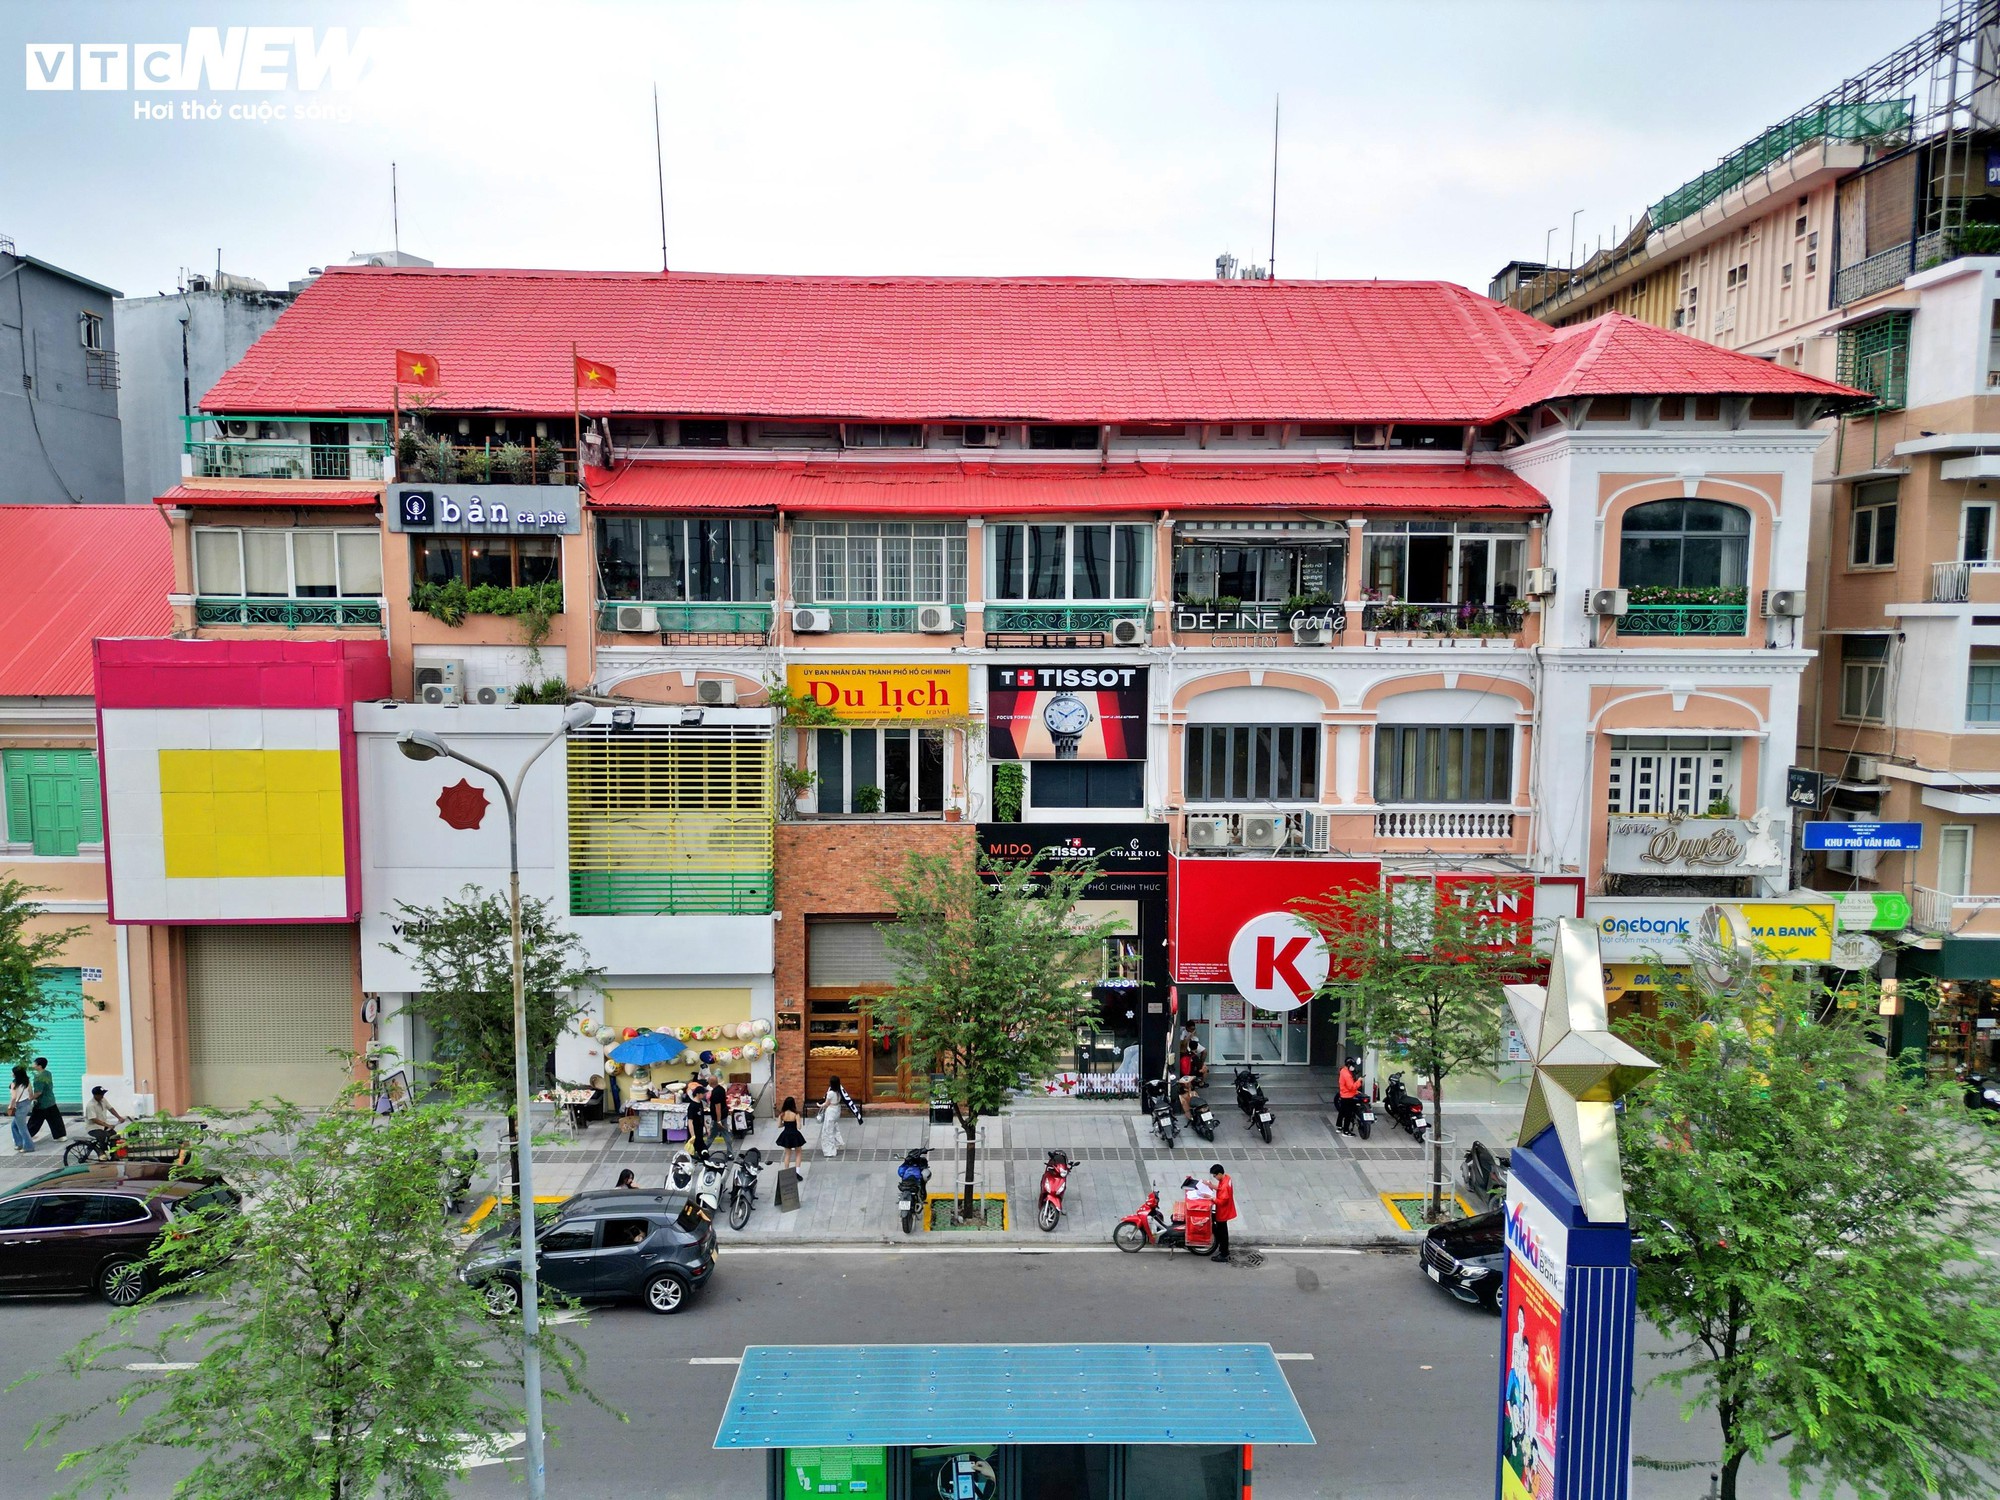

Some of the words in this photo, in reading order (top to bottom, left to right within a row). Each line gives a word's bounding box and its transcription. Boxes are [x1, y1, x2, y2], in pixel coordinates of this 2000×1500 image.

[441, 495, 508, 523] bản
[517, 510, 536, 523] cà
[539, 511, 567, 527] phê
[1178, 612, 1279, 630] DEFINE
[1289, 608, 1346, 631] Cafe
[1212, 635, 1279, 648] GALLERY
[868, 668, 892, 676] THÀNH
[893, 667, 907, 676] PHỐ
[921, 668, 932, 676] CHÍ
[1037, 669, 1136, 687] TISSOT
[807, 681, 866, 707] Du
[878, 680, 950, 713] lịch
[926, 708, 950, 716] travel
[1639, 827, 1744, 867] Quyền
[1825, 839, 1842, 847] KHU
[1845, 836, 1862, 847] PHỐ
[1864, 837, 1882, 847] VĂN
[1884, 837, 1901, 847] HÓA
[1050, 847, 1096, 857] TISSOT
[1110, 880, 1136, 891] CHÍNH
[1139, 881, 1161, 891] THỨC
[1636, 936, 1650, 944] mọi
[1779, 927, 1817, 937] BANK
[1255, 936, 1316, 1004] K
[1503, 1200, 1539, 1269] Vikki
[1540, 1249, 1555, 1269] Digital
[1539, 1260, 1558, 1290] Bank
